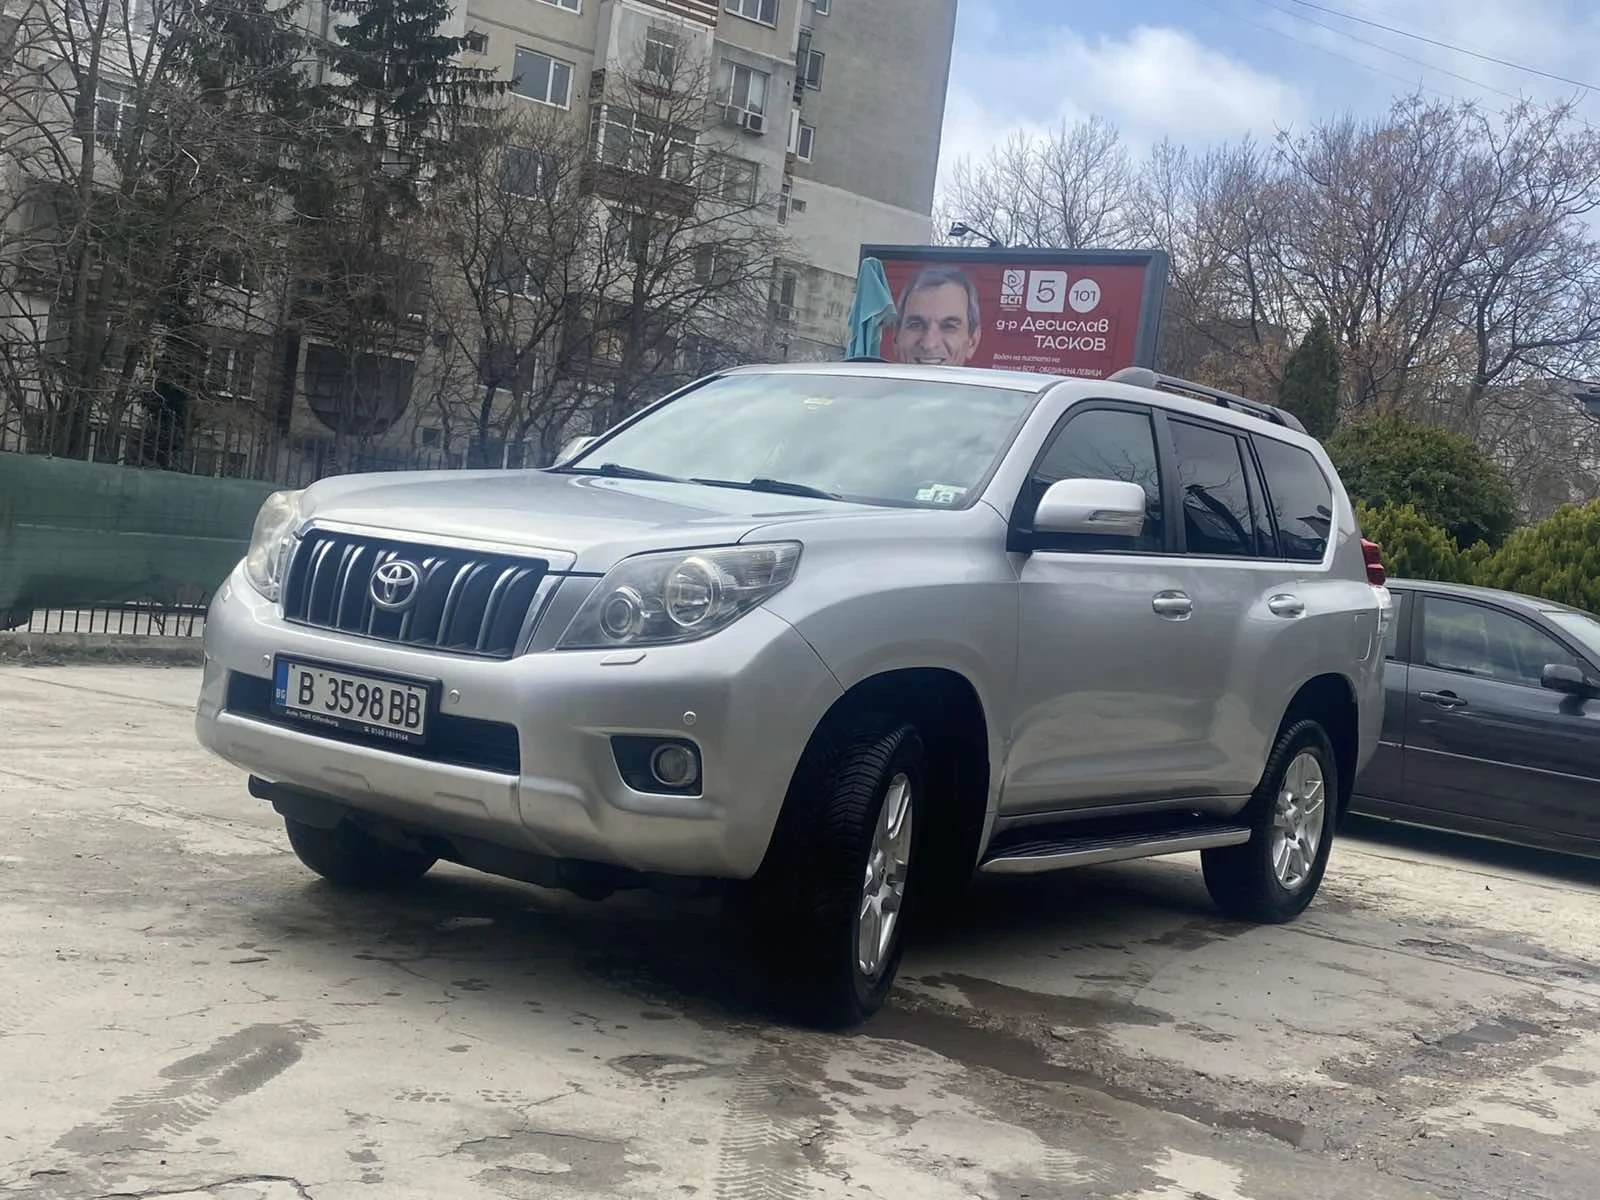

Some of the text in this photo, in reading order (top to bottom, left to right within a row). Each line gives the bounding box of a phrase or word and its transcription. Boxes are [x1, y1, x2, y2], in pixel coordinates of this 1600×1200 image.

[1000, 295, 1023, 305] БСП
[1036, 280, 1055, 303] 5
[1073, 290, 1096, 302] 101
[1020, 316, 1109, 333] Десислав
[1034, 335, 1107, 352] ТАСКОВ
[275, 687, 286, 700] BG
[298, 672, 421, 728] B 3598 BB
